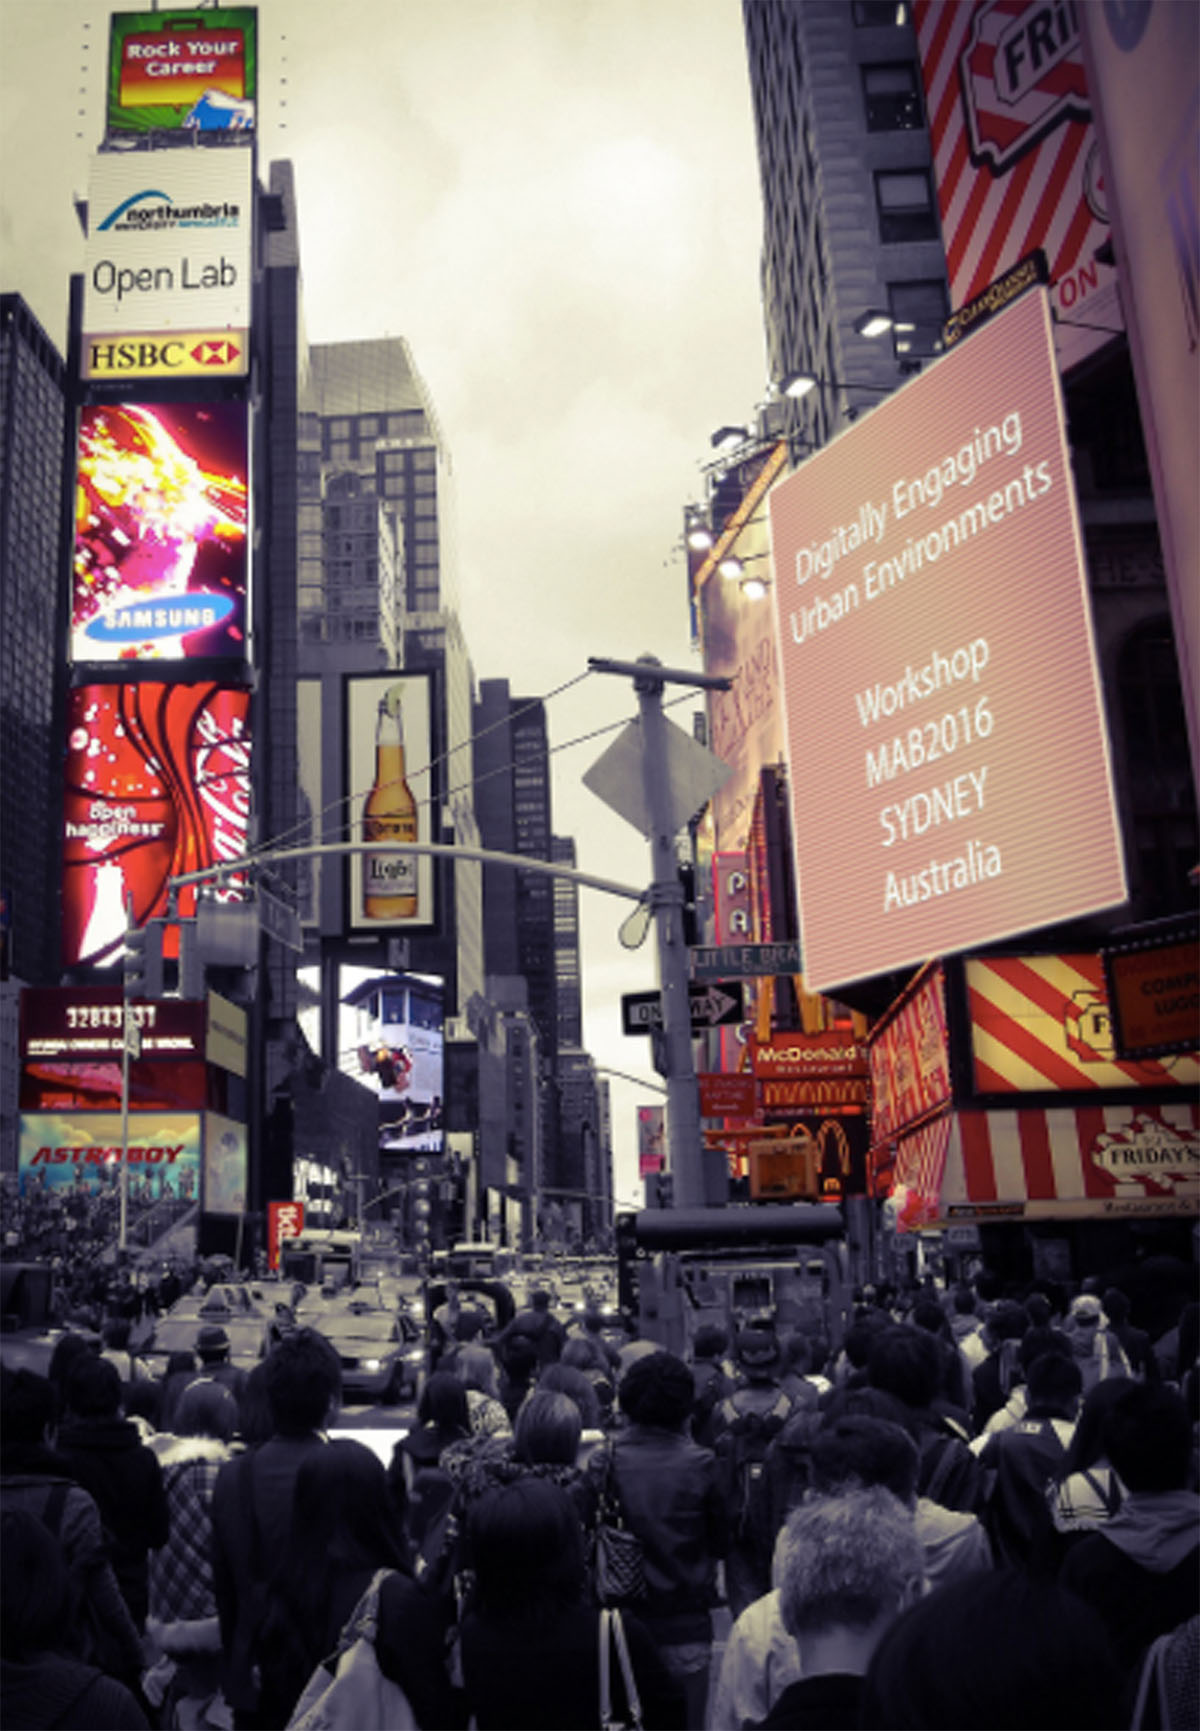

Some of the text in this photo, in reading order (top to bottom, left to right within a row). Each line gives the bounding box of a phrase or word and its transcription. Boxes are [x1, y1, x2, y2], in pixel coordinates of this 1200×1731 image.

[128, 40, 239, 59] Rock Your
[147, 59, 217, 76] Career
[127, 203, 240, 222] northumbria
[93, 256, 237, 300] Open Lab
[90, 342, 185, 370] HSBC
[795, 411, 1023, 585] Digitally Engaging
[790, 460, 1053, 644] Urban Environments
[104, 608, 217, 630] SAMSUNG
[855, 638, 991, 728] Workshop
[865, 696, 995, 789] MAB2016
[879, 766, 990, 847] SYDNEY
[883, 840, 1003, 913] Australia
[639, 1005, 662, 1022] ON
